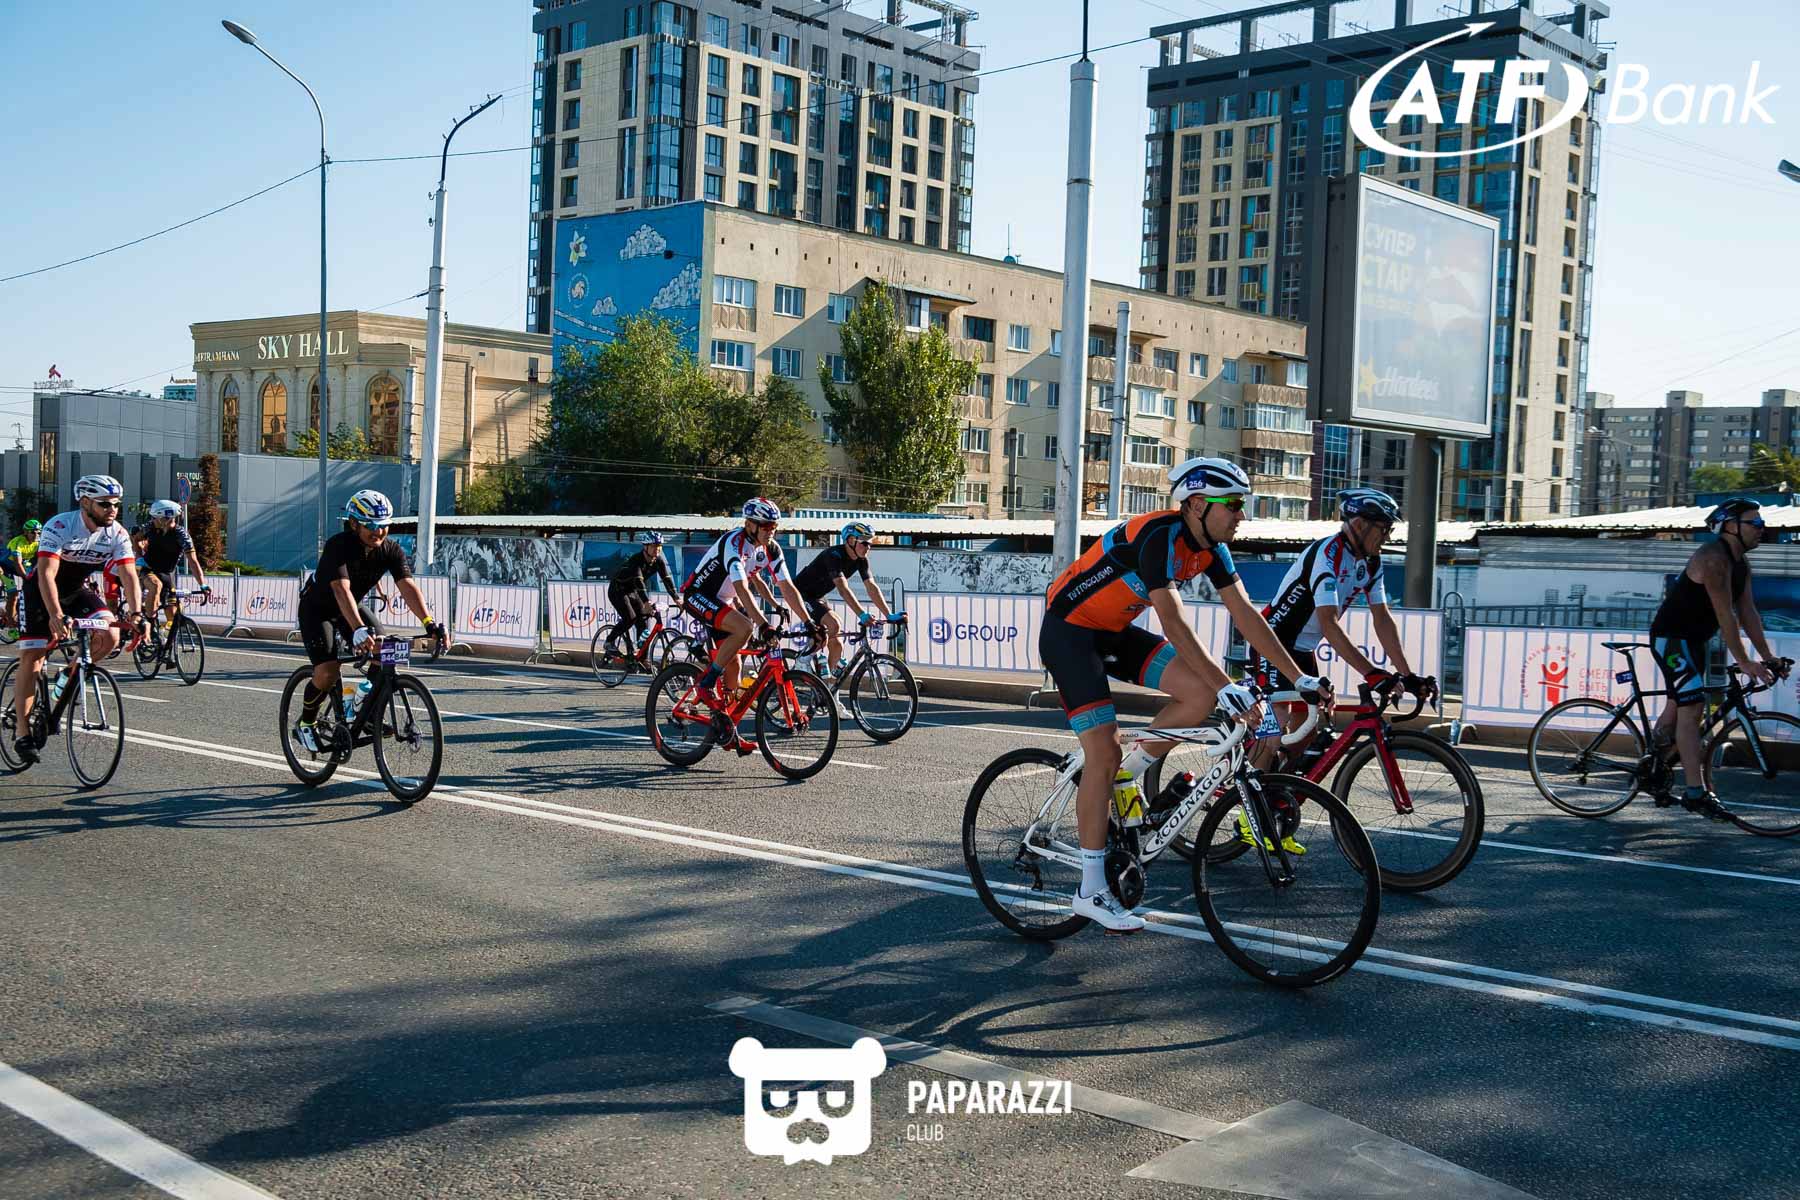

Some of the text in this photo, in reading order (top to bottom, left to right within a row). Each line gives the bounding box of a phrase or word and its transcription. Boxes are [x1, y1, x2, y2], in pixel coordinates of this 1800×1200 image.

[257, 330, 349, 360] SKY HALL
[1188, 480, 1203, 489] 256
[62, 548, 113, 559] TREK
[709, 558, 720, 571] CITY
[1287, 583, 1306, 604] CITY
[250, 596, 286, 610] ATF Bank
[473, 607, 522, 625] ATF Bank
[569, 606, 591, 621] ATF
[931, 622, 1018, 643] BI GROUP
[1160, 766, 1222, 837] COLNAGO
[1237, 783, 1259, 832] COLNAGO
